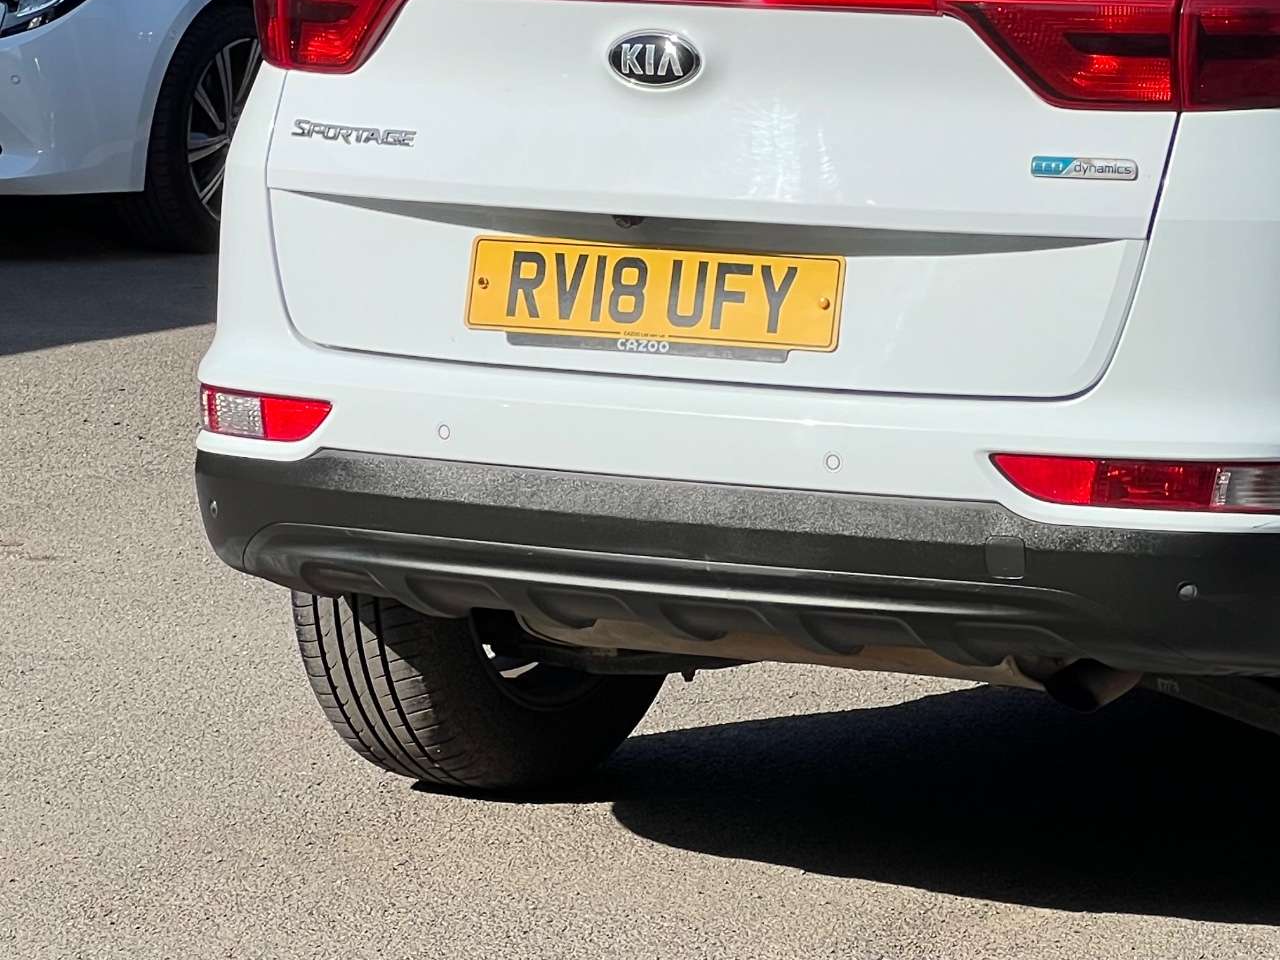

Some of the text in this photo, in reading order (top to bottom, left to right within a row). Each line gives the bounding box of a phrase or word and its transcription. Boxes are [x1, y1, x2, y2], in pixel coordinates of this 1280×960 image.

[621, 40, 684, 77] KIA
[291, 118, 417, 147] SPORTAGE
[505, 250, 798, 334] RV18 UFY
[616, 339, 670, 353] CAZOO
